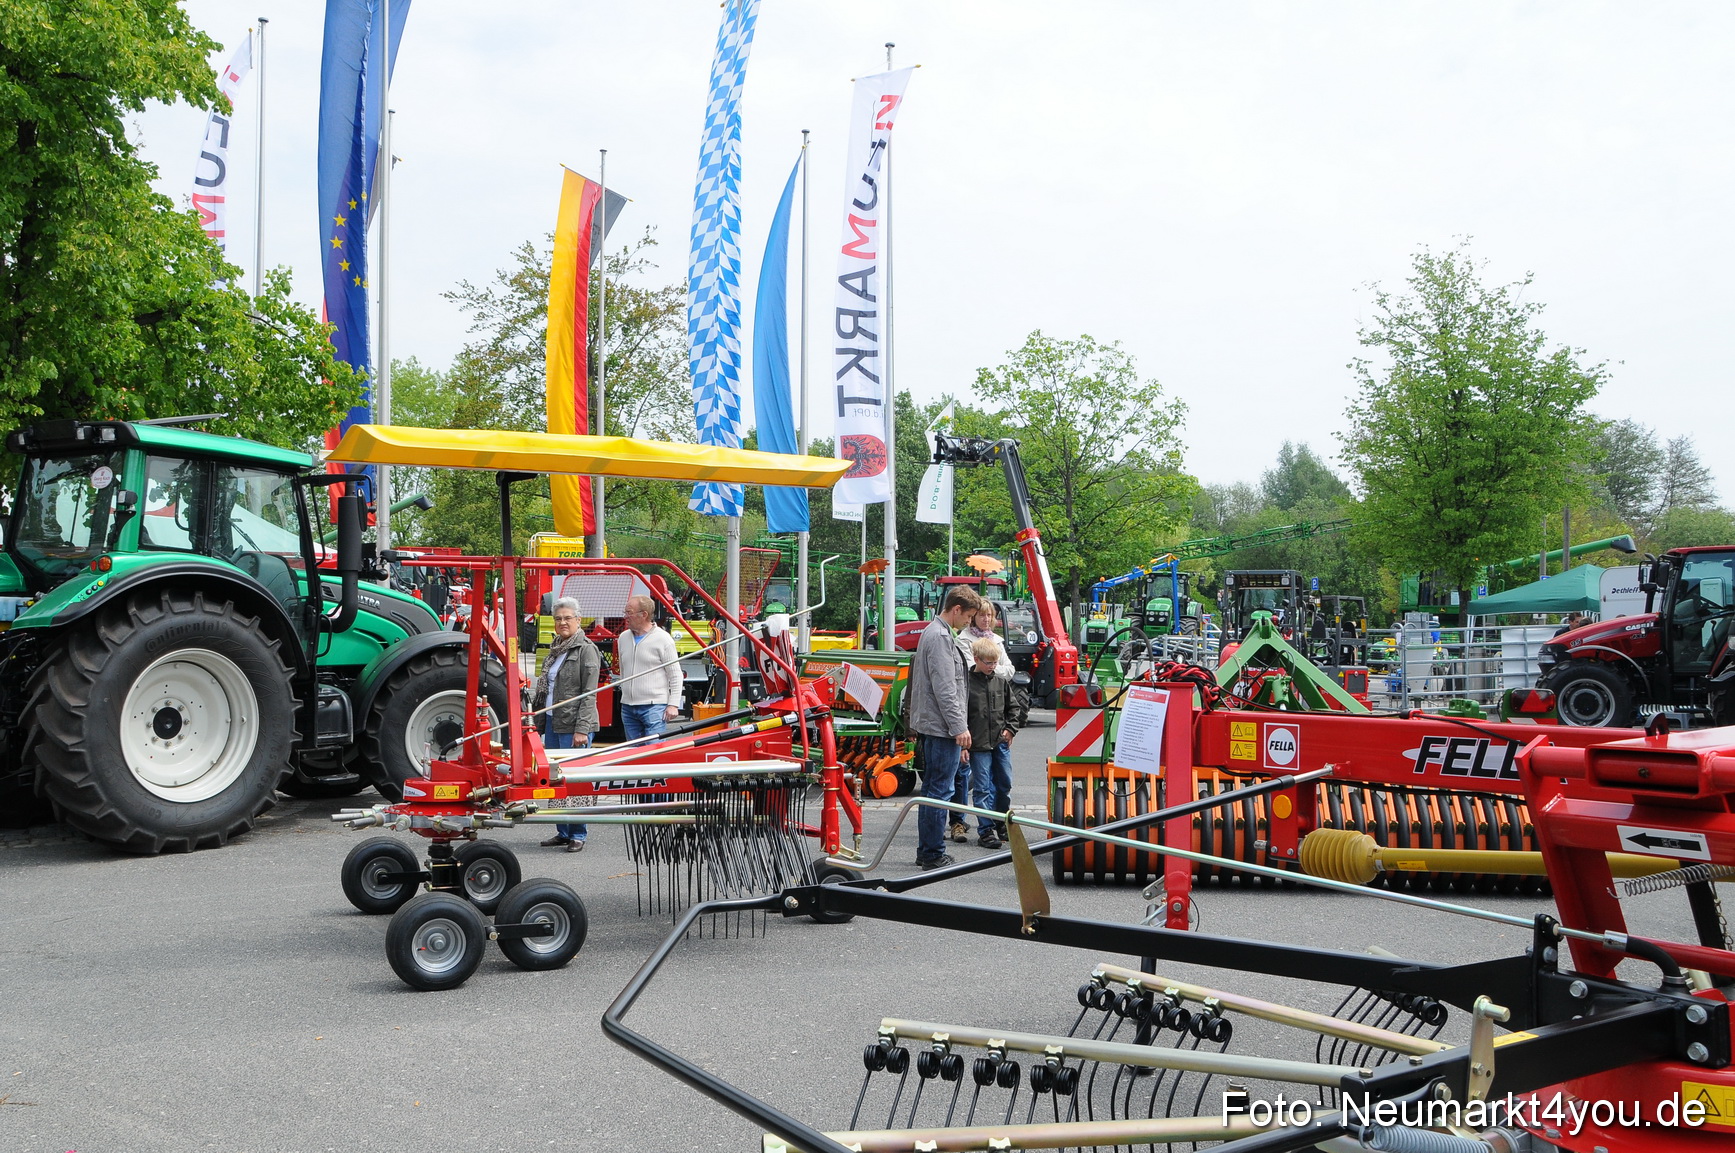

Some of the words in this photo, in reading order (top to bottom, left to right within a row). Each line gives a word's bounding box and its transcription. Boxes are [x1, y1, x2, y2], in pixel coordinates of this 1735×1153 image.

[1029, 632, 1036, 642] 20
[1269, 740, 1294, 752] FELLA
[1413, 736, 1522, 780] FELL
